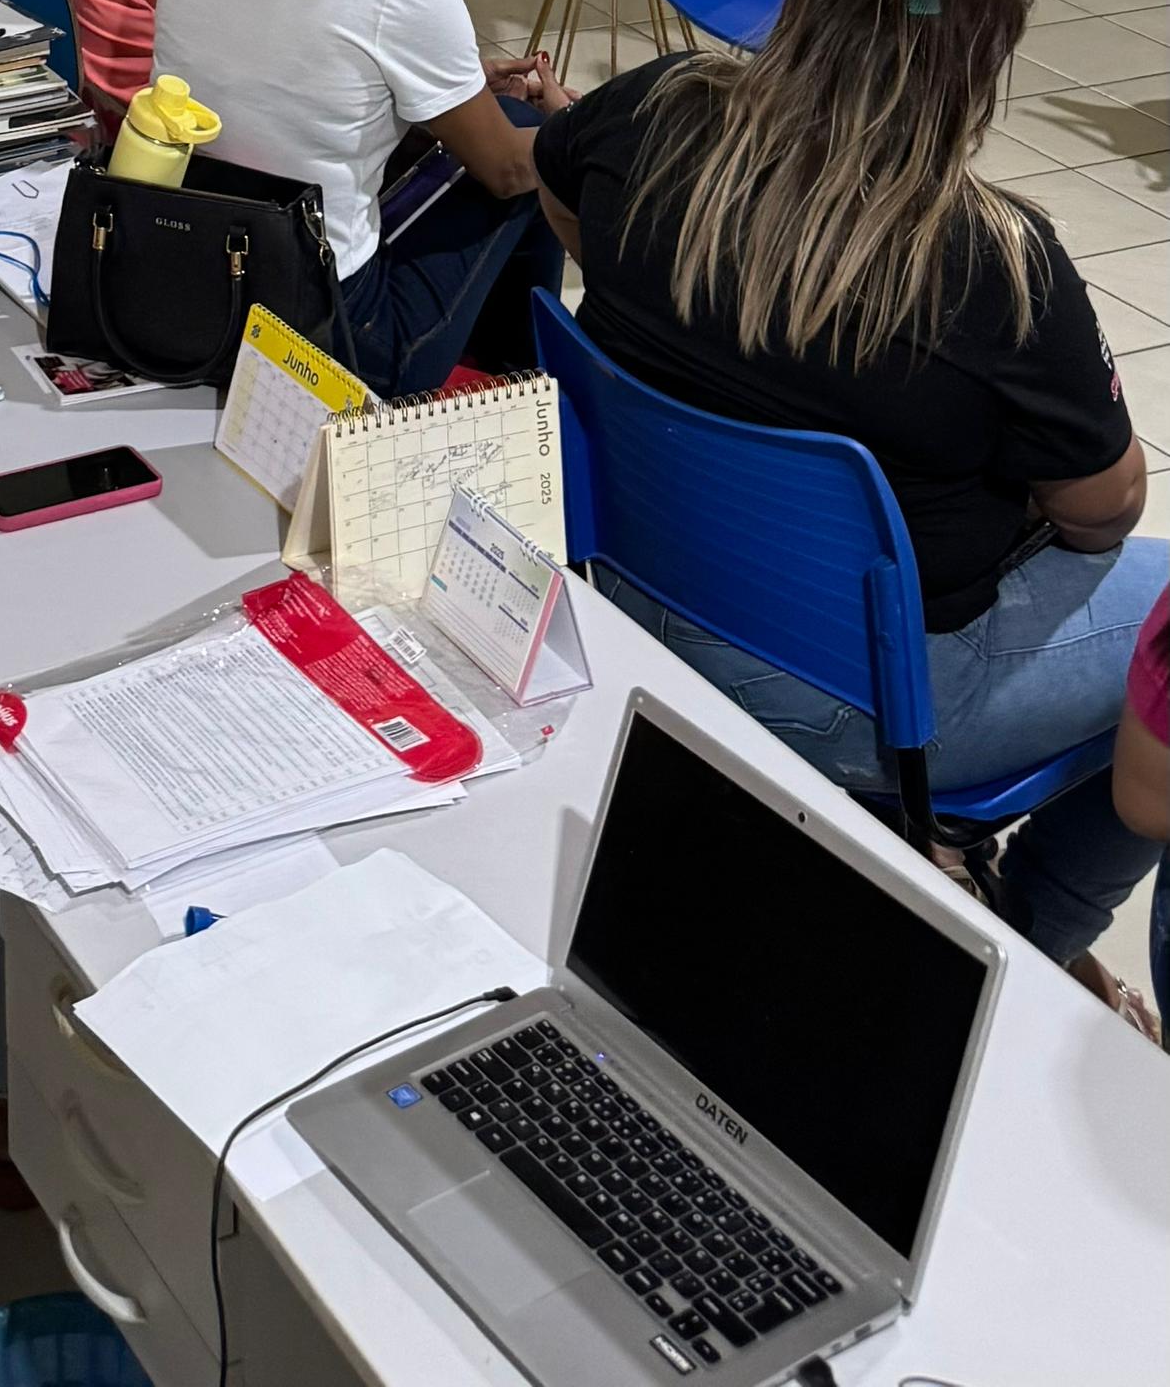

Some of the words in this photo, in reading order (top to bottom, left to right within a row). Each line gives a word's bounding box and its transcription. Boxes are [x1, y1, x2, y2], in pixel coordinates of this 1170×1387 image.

[156, 217, 190, 231] GLOSS
[282, 349, 319, 387] Junho
[536, 399, 553, 457] Junho
[540, 472, 552, 505] 2025
[696, 1093, 748, 1145] DATEN
